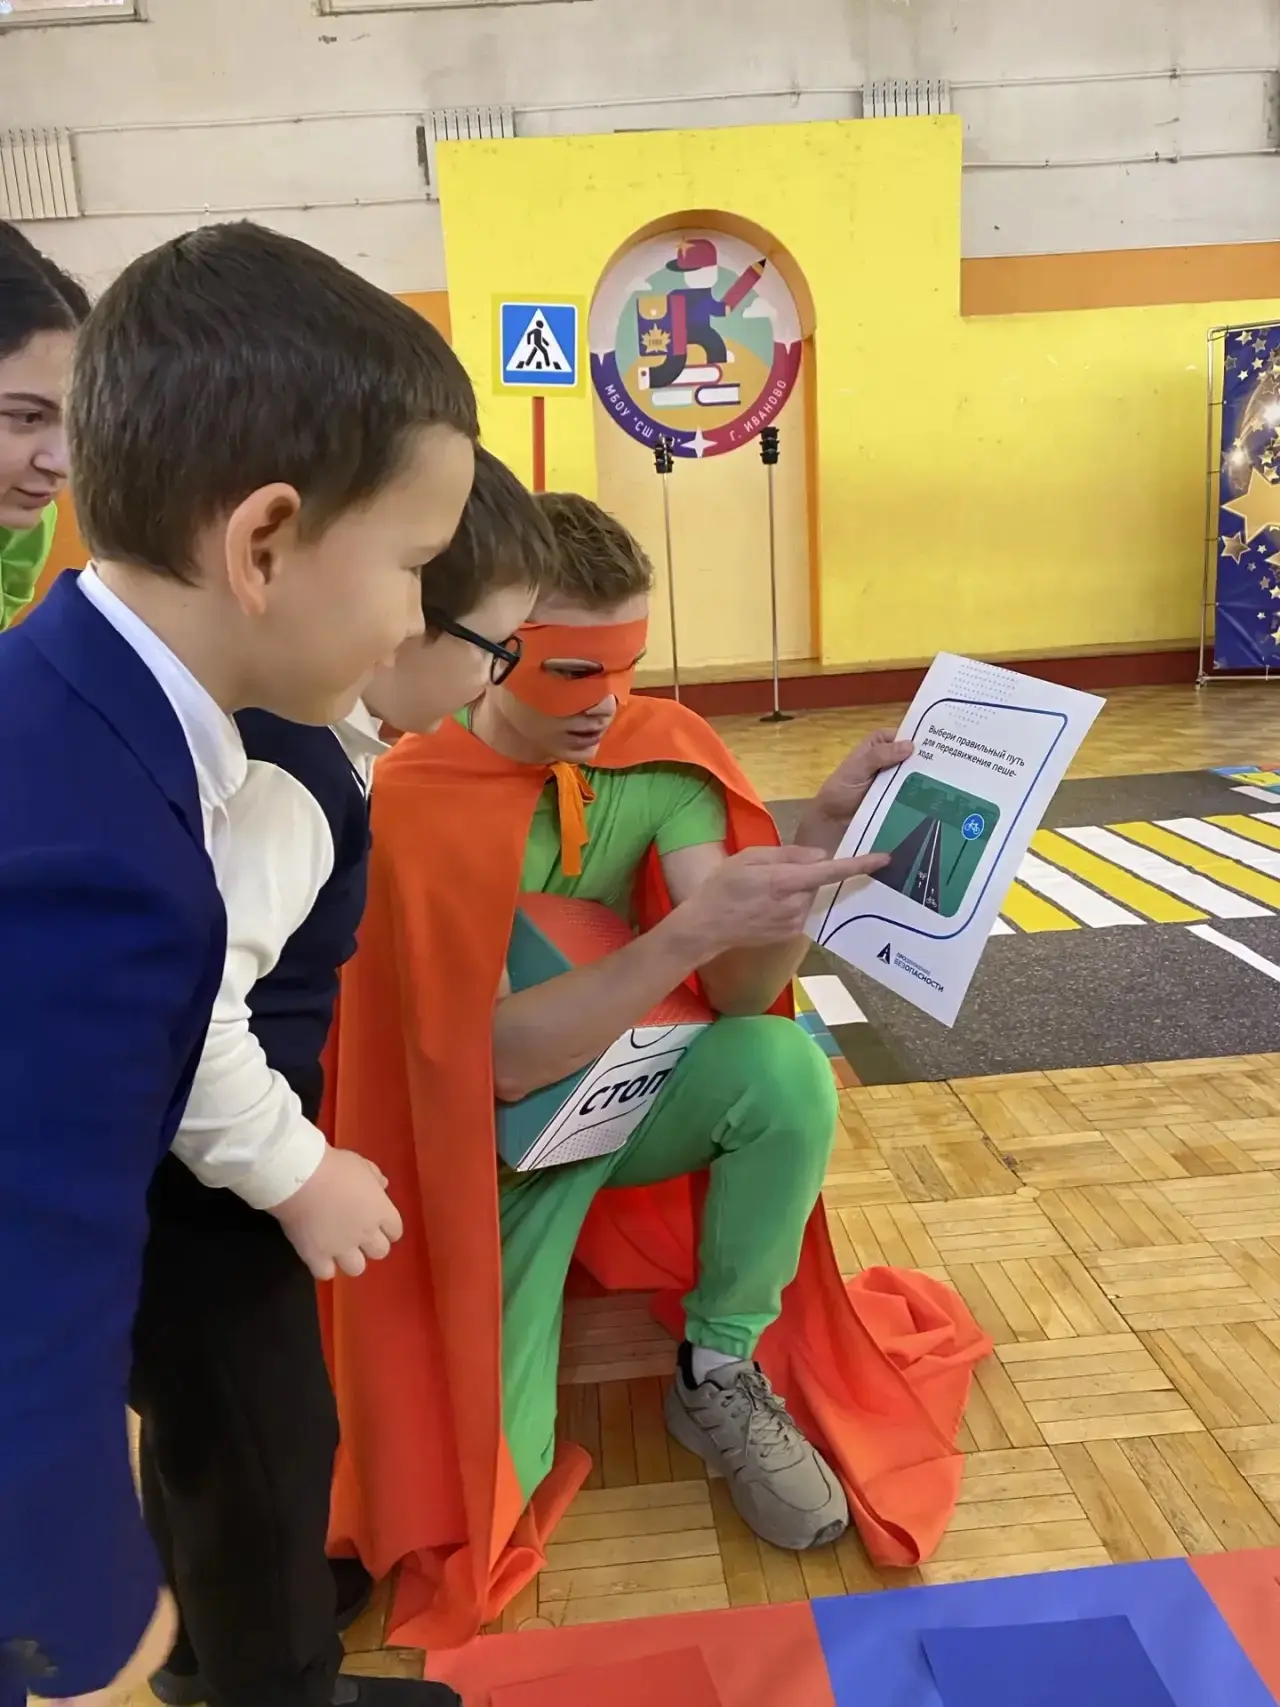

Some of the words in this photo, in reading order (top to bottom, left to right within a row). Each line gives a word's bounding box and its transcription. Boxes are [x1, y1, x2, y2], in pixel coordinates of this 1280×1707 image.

[604, 384, 631, 416] МБОУ
[729, 430, 742, 441] Г.
[743, 380, 787, 432] ИВАНОВО
[922, 738, 936, 747] для
[935, 742, 992, 768] передвижения
[991, 762, 1017, 777] пеше-
[928, 724, 956, 741] Выбери
[956, 736, 1006, 760] правильный
[1005, 754, 1025, 767] путь
[579, 1068, 673, 1115] СТОП
